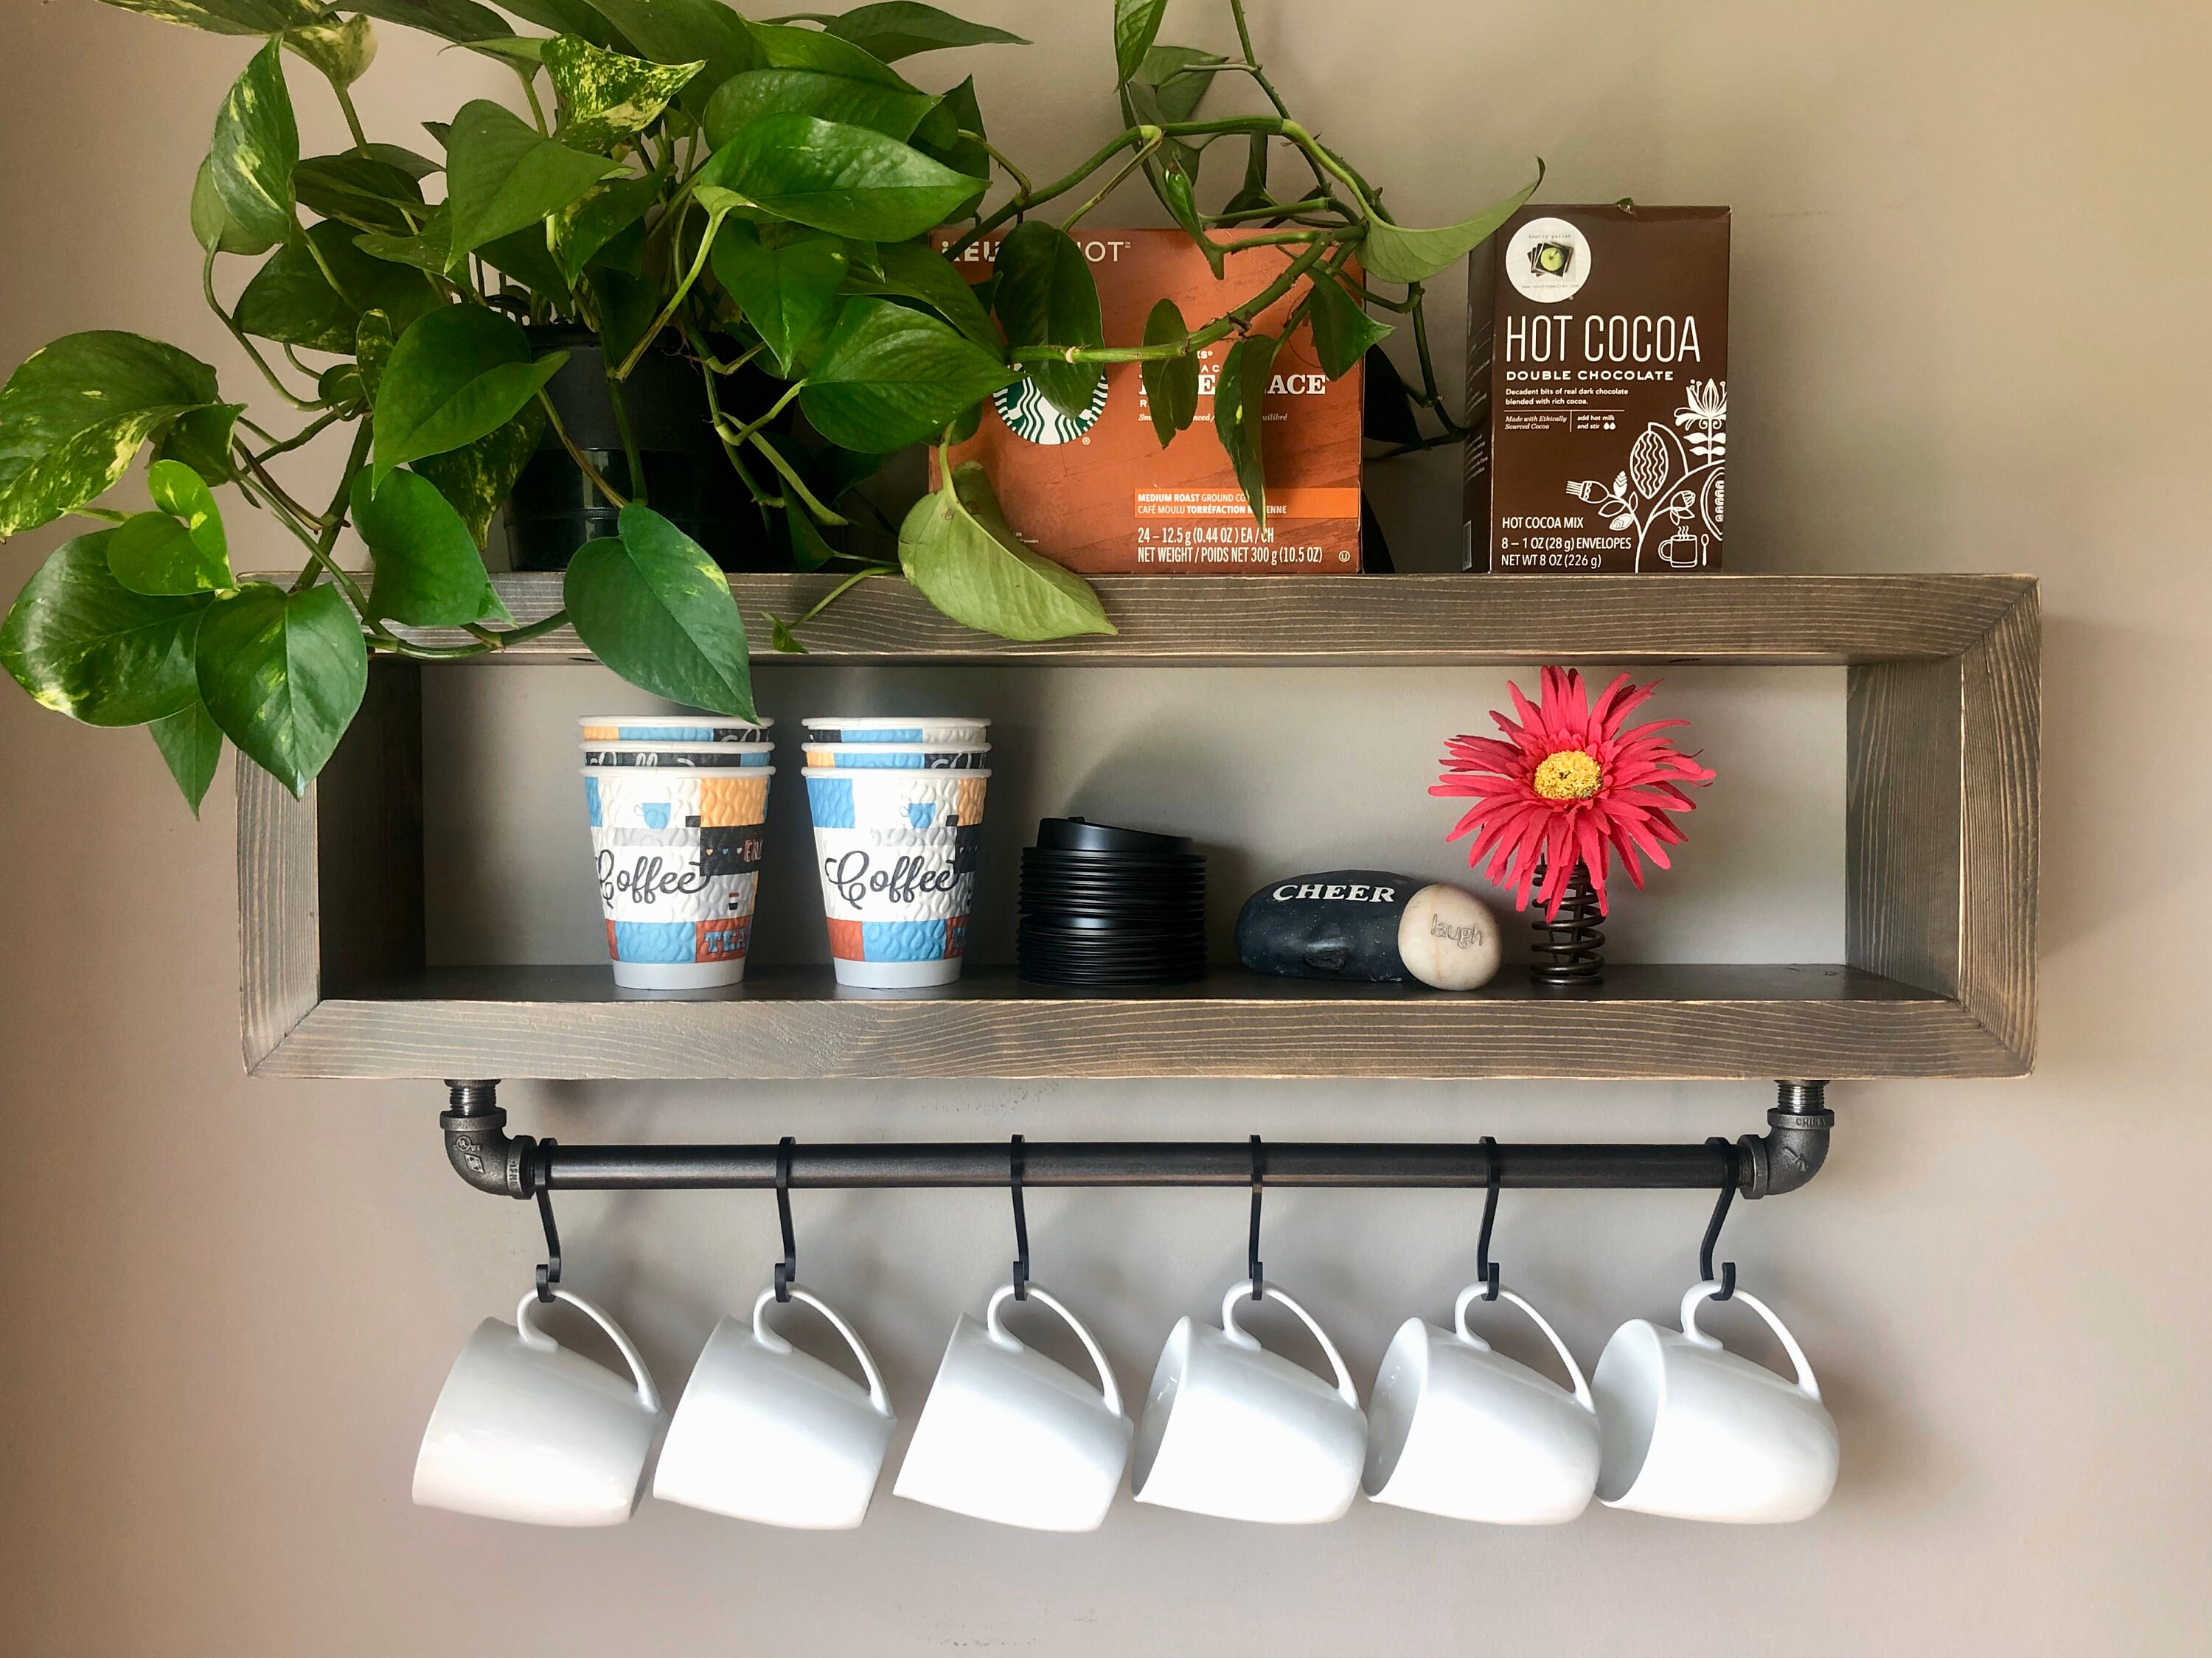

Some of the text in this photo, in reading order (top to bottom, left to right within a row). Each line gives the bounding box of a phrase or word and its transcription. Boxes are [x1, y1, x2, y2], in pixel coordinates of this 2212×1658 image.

[1077, 242, 1124, 262] OT
[1507, 316, 1573, 362] HOT
[1585, 316, 1700, 362] COCOA
[1507, 371, 1673, 380] DOUBLE CHOCOLATE
[1138, 494, 1172, 502] MEDIUM
[1174, 494, 1200, 502] ROAST
[1201, 494, 1234, 502] GROUND
[1138, 504, 1155, 514] CAFÉ
[1158, 506, 1185, 514] MOULU
[1186, 504, 1245, 514] TORRÉFACTION
[1503, 517, 1583, 529] HOT COCOA MIX
[1138, 528, 1150, 543] 24
[1162, 528, 1183, 543] 12.5
[1185, 532, 1191, 546] g
[1193, 528, 1217, 544] (0.44
[1220, 528, 1231, 543] OZ
[1241, 528, 1253, 543] EA
[1501, 538, 1508, 549] 8
[1523, 538, 1528, 549] 1
[1531, 538, 1545, 549] OZ
[1545, 537, 1562, 551] (28
[1565, 537, 1574, 552] g)
[1576, 537, 1631, 549] ENVELOPES
[1138, 547, 1154, 562] NET
[1158, 547, 1193, 562] WEIGHT
[1201, 547, 1228, 562] POIDS
[1231, 547, 1248, 562] NET
[1251, 547, 1269, 562] 300
[1271, 551, 1277, 565] g
[1279, 547, 1303, 563] (10.5
[1307, 547, 1322, 563] OZ)
[1501, 554, 1601, 568] NET WT 8 OZ (226 g)
[597, 849, 710, 909] Coffee
[824, 851, 959, 910] Coffee
[1273, 884, 1395, 902] CHEER
[705, 928, 745, 952] TEA
[1430, 914, 1484, 949] laugh
